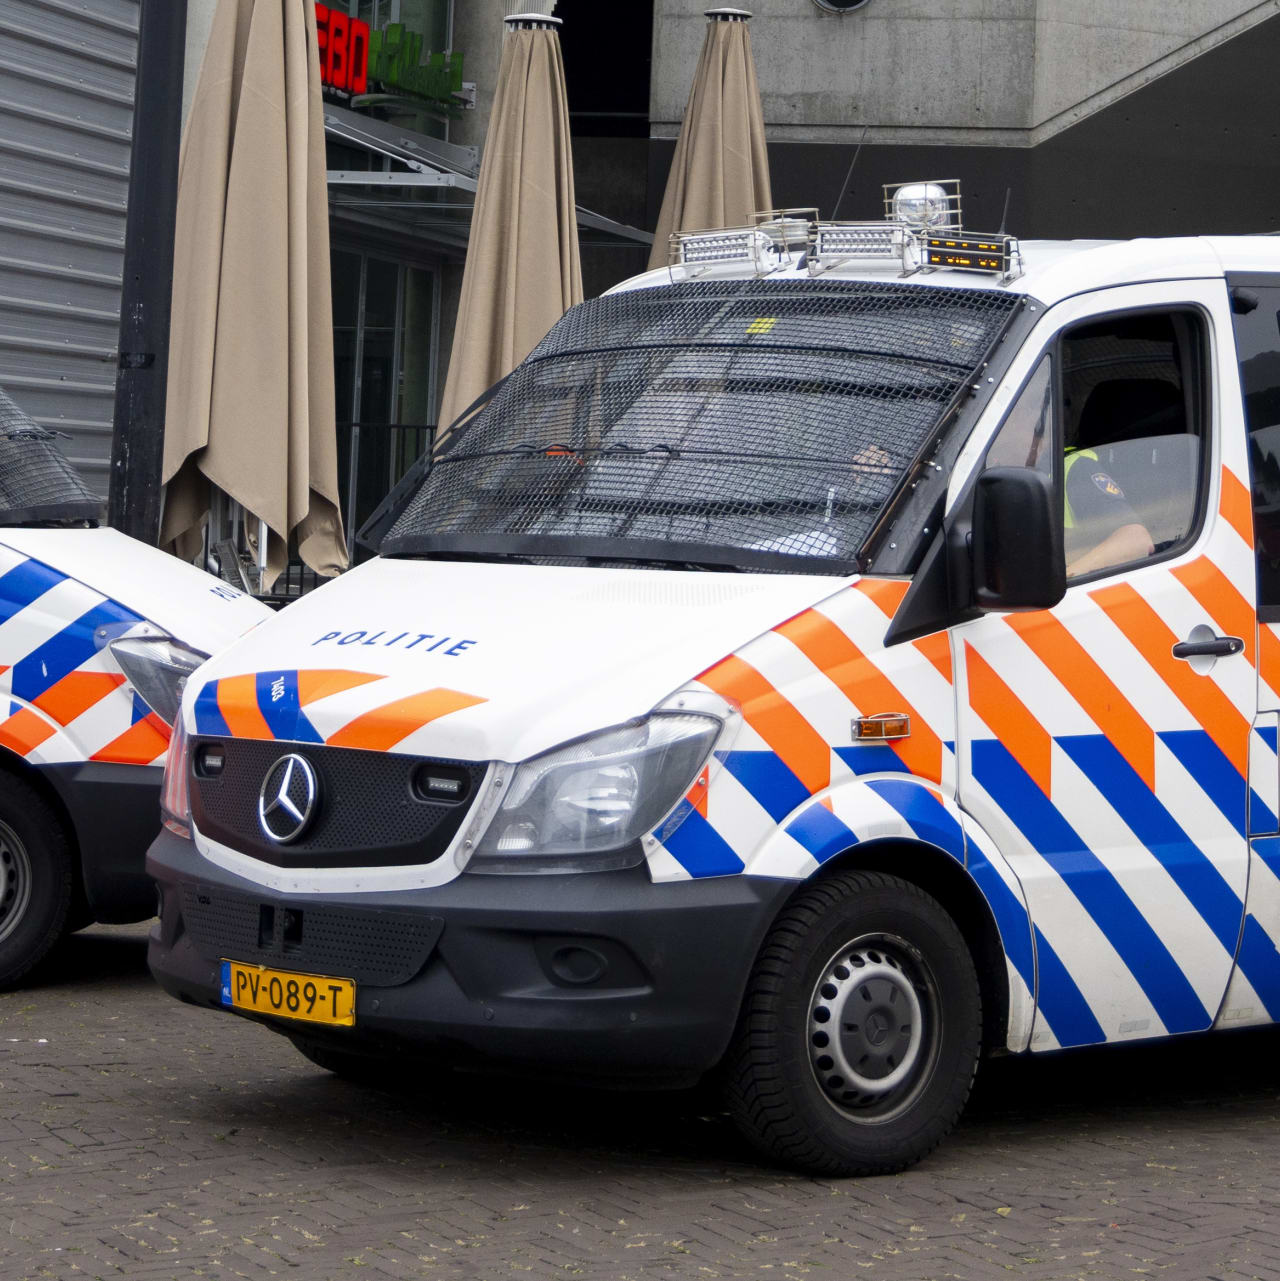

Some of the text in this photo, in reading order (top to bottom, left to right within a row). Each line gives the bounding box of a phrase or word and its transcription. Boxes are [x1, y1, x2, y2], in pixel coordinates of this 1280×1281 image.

[314, 1, 370, 95] EBO
[312, 630, 479, 658] POLITIE
[236, 969, 343, 1018] PV-089-T
